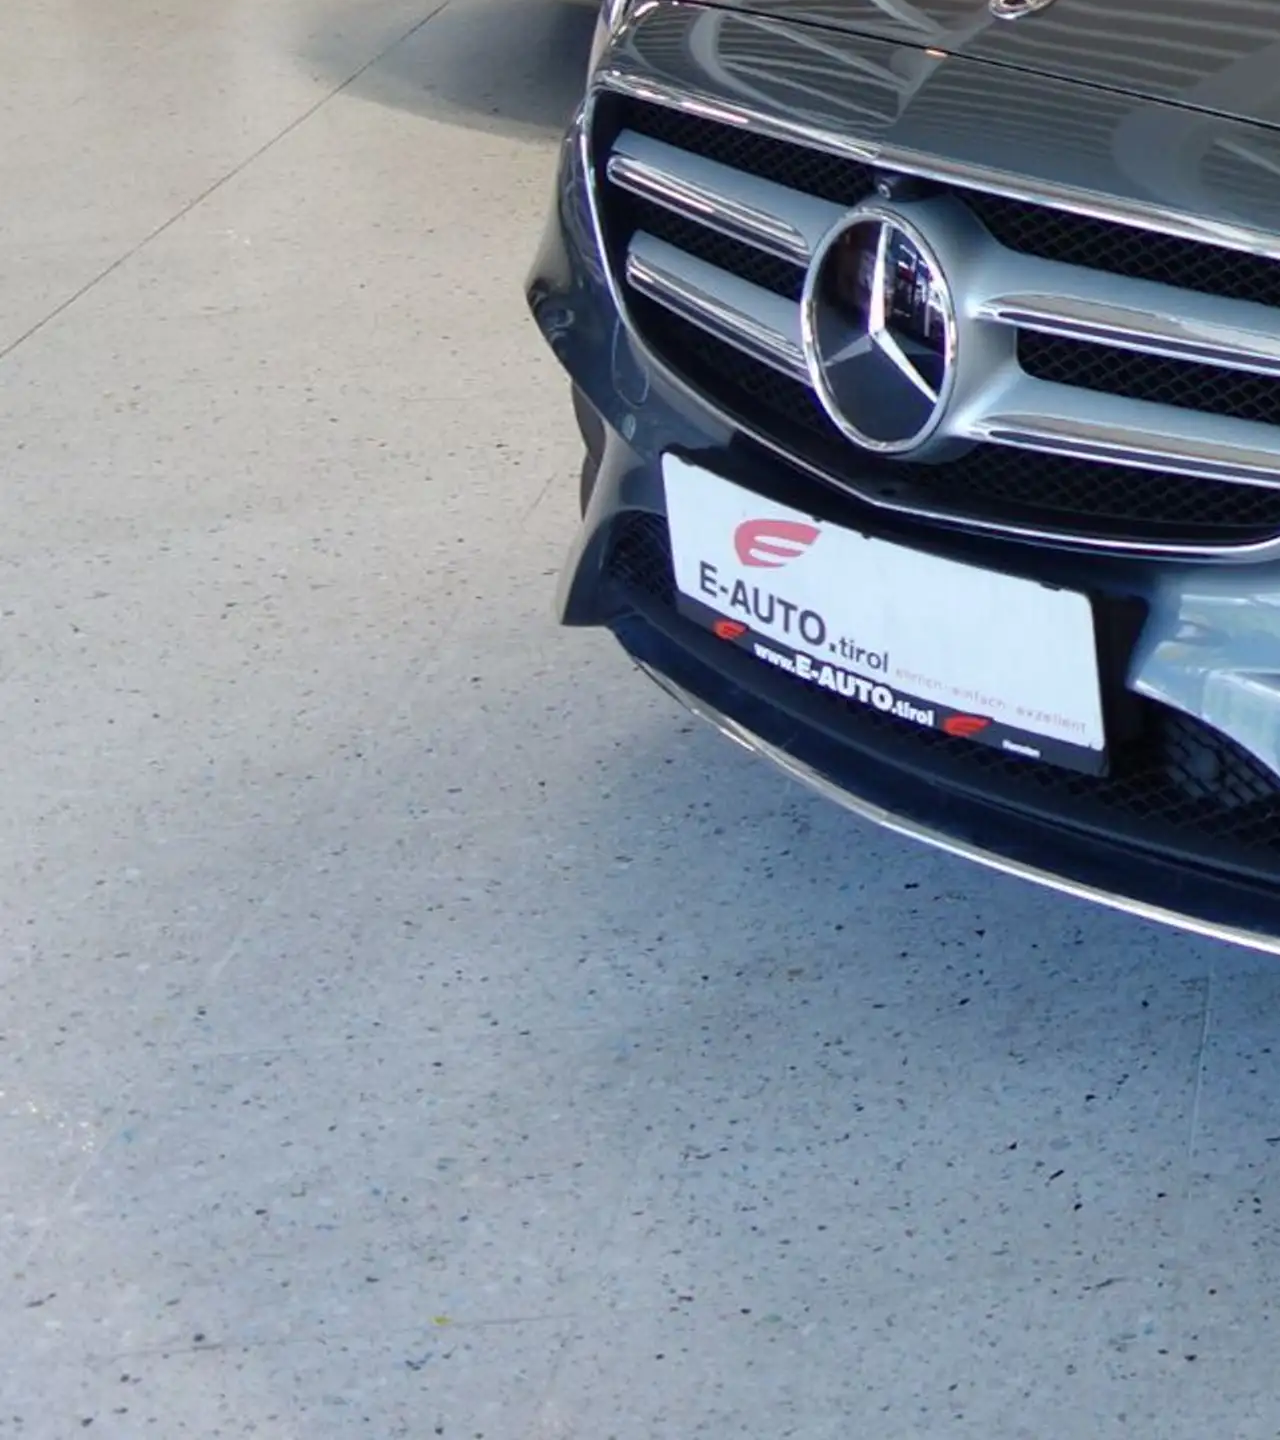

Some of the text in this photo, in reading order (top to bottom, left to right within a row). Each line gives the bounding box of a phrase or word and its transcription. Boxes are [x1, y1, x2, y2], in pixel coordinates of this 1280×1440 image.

[700, 560, 890, 673] E-AUTO.tirol
[754, 642, 934, 726] www.E-AUTO.tirol
[1016, 705, 1087, 735] exzellent
